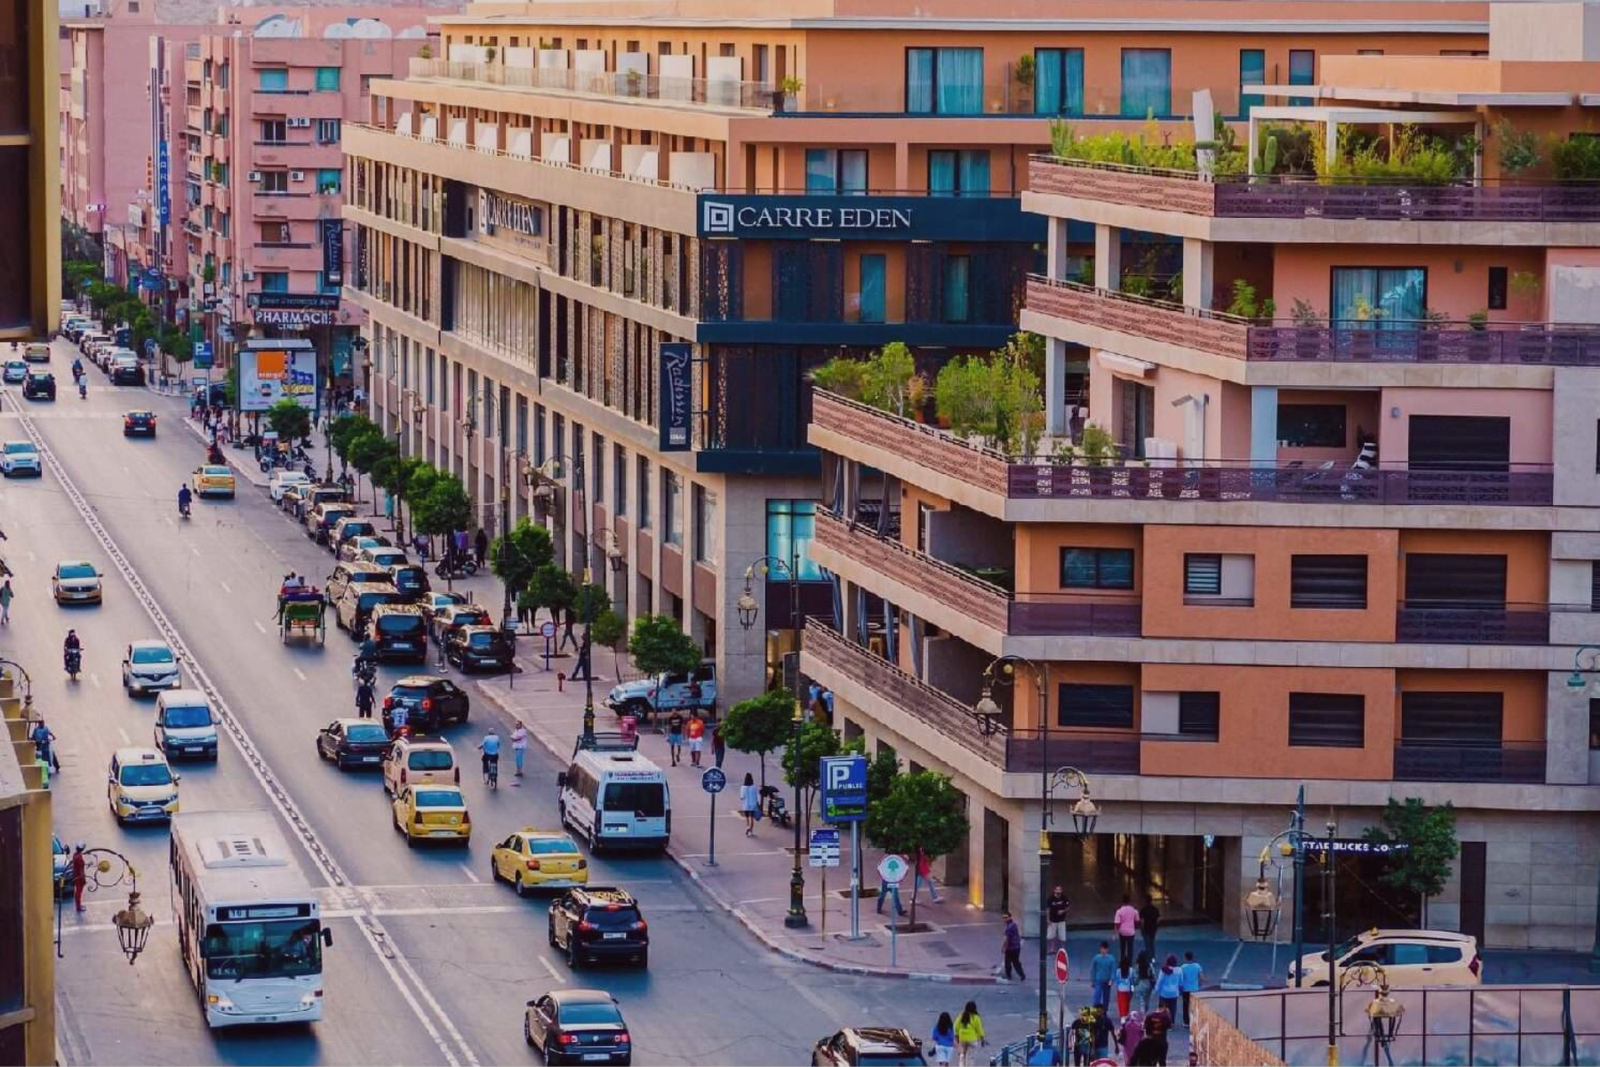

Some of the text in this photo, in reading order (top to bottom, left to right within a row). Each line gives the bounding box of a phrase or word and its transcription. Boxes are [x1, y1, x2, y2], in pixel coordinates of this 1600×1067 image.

[487, 194, 512, 229] CARRE
[738, 206, 913, 228] CARRE EDEN
[255, 311, 332, 325] PHARMACIE
[195, 342, 205, 356] P
[663, 347, 691, 426] Radisson
[832, 766, 850, 790] P
[1302, 841, 1369, 851] STARBUCKS
